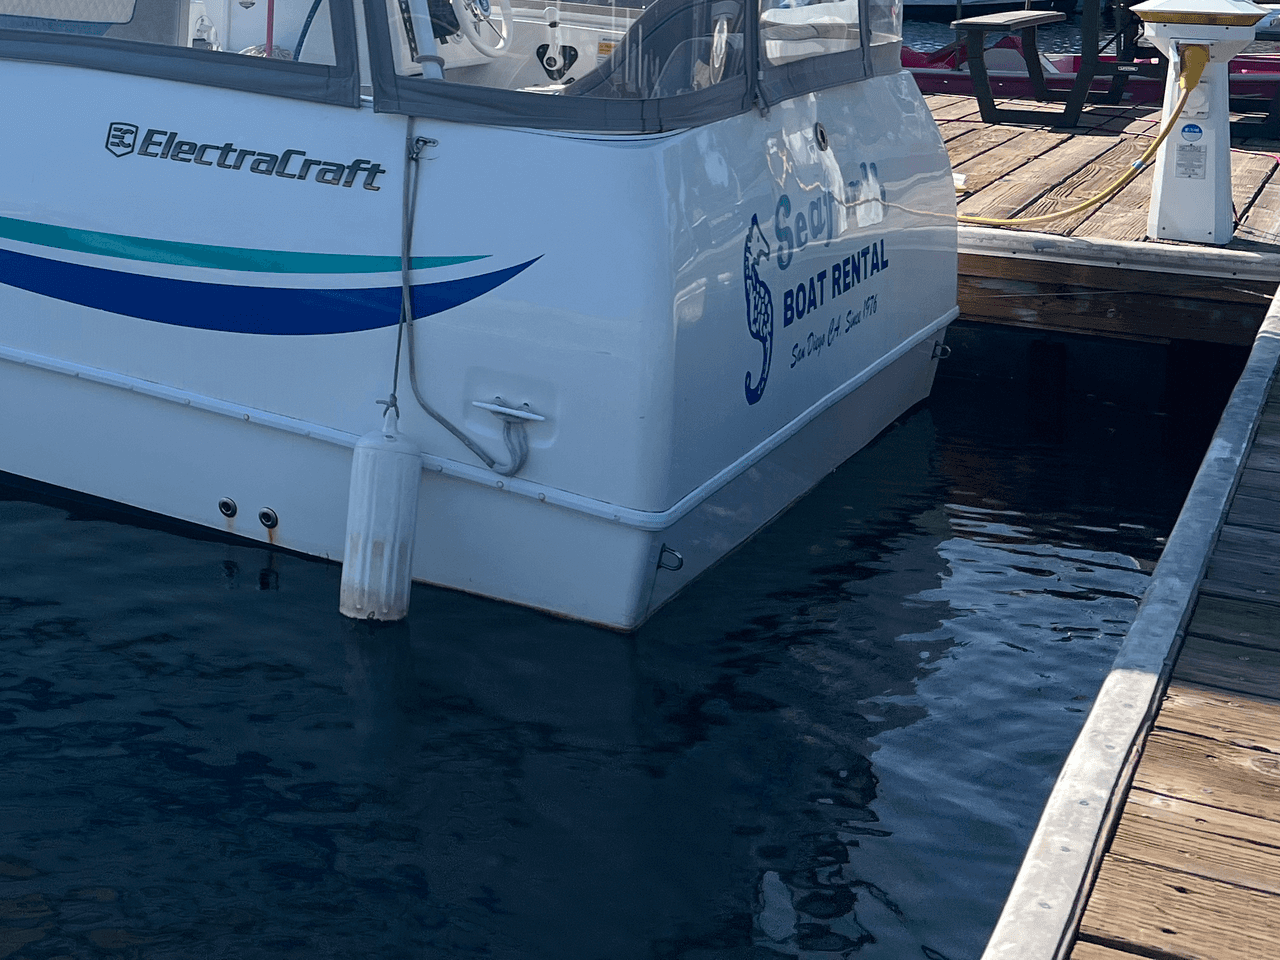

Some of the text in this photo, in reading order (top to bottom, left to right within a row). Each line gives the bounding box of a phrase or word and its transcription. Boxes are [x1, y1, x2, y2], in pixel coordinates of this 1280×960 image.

[137, 128, 386, 192] ElectraCraft
[775, 161, 888, 270] Seafr
[783, 239, 889, 328] BOAT RENTAL
[790, 342, 806, 369] San
[845, 310, 862, 334] Since
